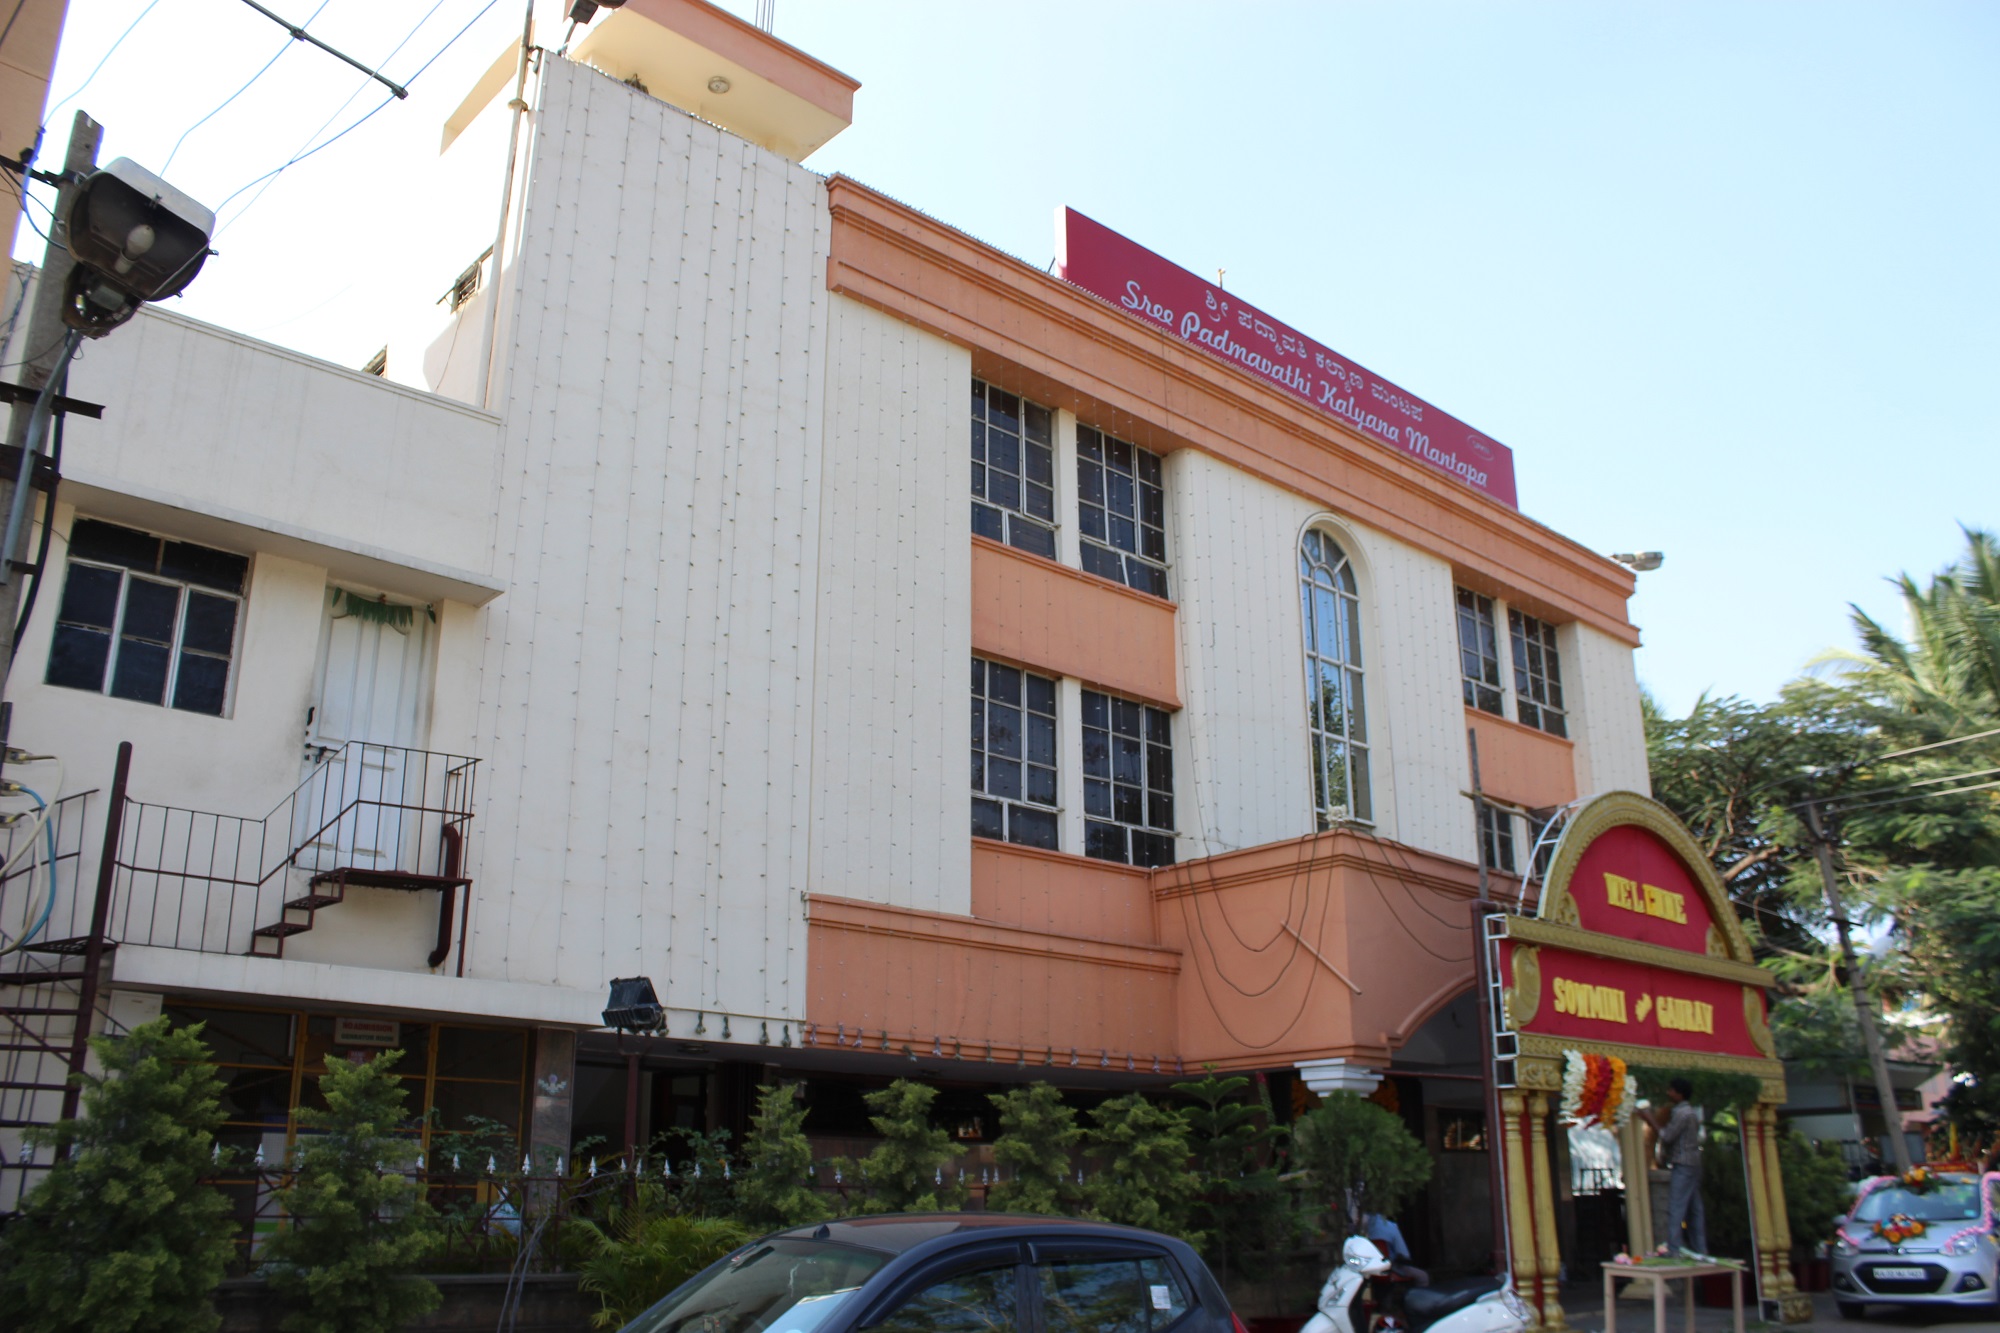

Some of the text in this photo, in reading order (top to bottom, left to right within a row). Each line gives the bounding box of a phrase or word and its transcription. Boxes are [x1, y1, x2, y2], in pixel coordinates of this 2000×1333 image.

[1205, 290, 1228, 323] ಶ್ರೀ
[1121, 280, 1488, 488] Sree Padmavathi Kalyana Mantapa
[1603, 871, 1688, 926] WELCOME
[342, 1022, 393, 1033] NO ADMISSION
